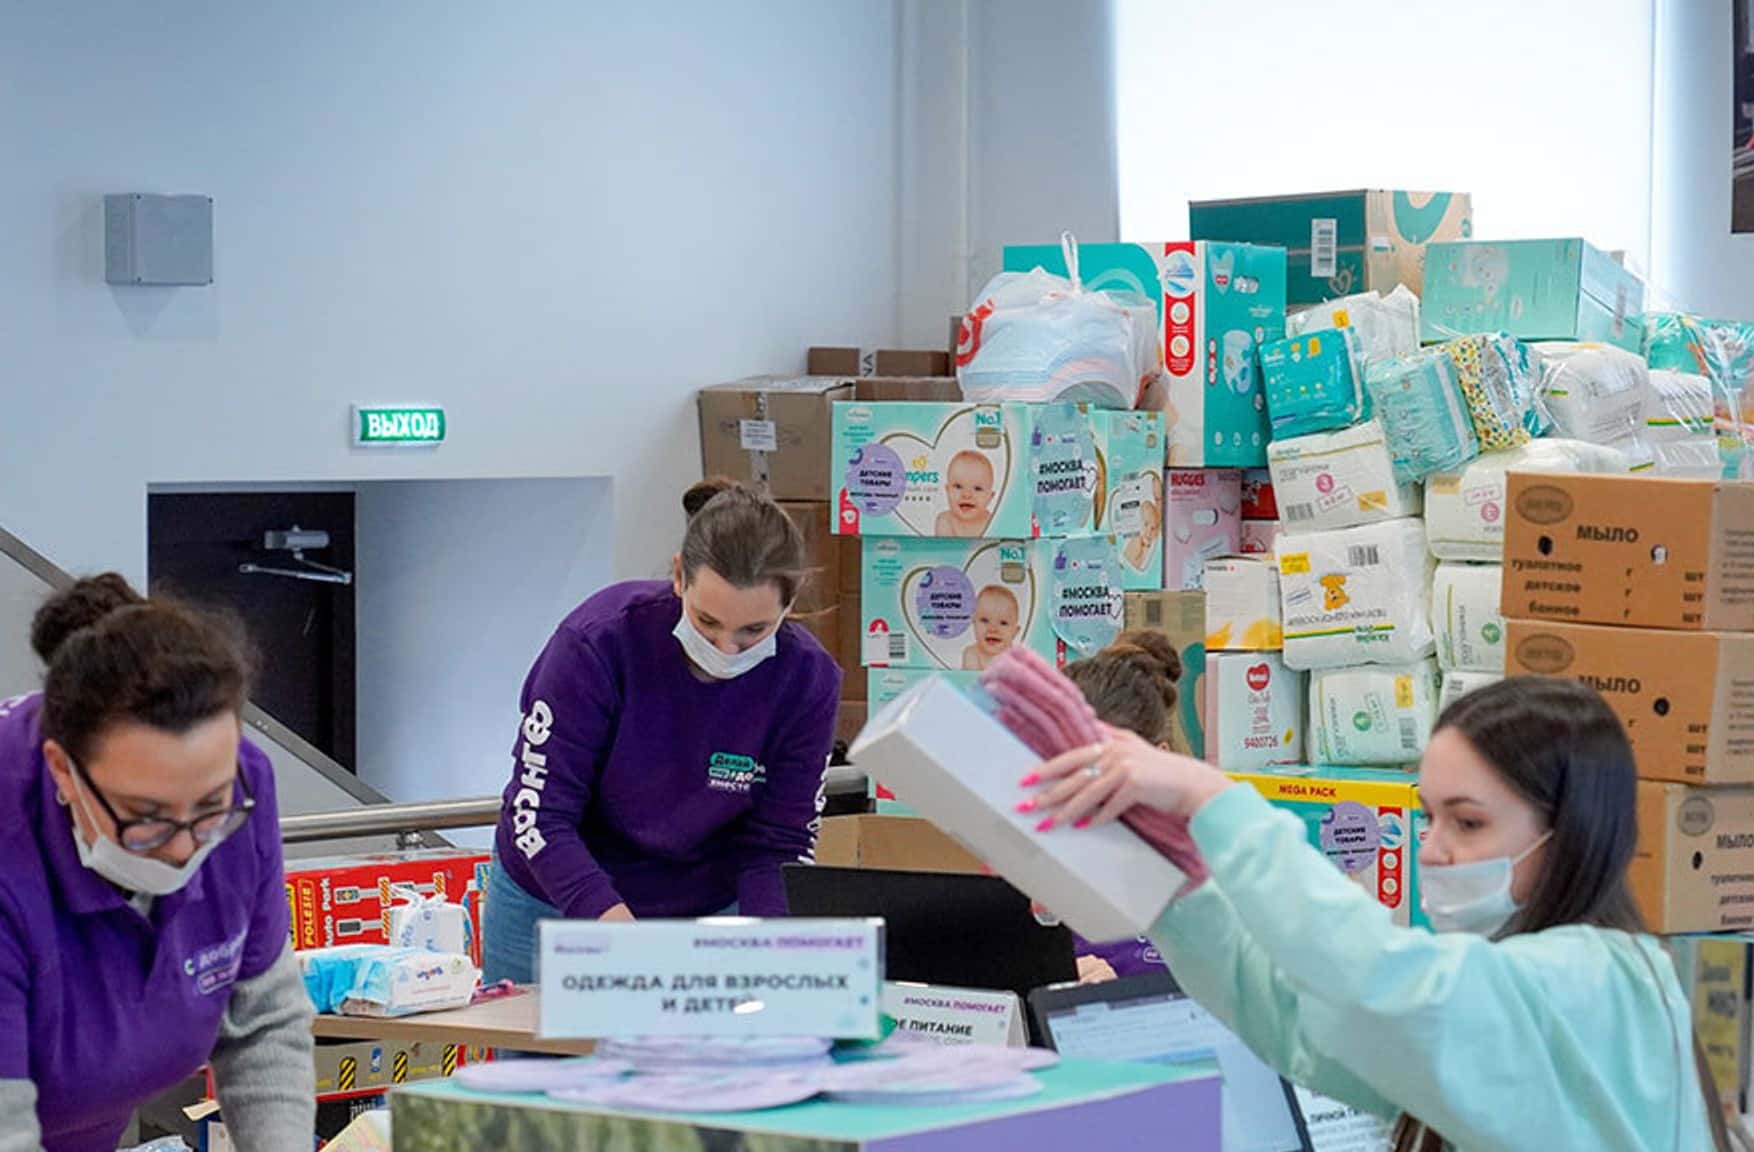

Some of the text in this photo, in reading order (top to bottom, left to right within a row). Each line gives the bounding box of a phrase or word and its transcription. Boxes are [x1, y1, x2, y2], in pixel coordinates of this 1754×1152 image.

[367, 412, 440, 438] ВЫХОД
[1039, 459, 1083, 475] #МОСКВА
[1037, 476, 1086, 494] ПОМОГАЕТ
[1576, 525, 1639, 543] МЫЛО
[1511, 559, 1583, 573] туалетное
[1062, 586, 1110, 599] #МОСКВА
[1524, 580, 1582, 593] детское
[1059, 602, 1113, 617] ПОМОГАЕТ
[1529, 601, 1581, 616] банное
[1279, 785, 1337, 798] MEGA PACK
[302, 887, 315, 945] POLESIE
[693, 936, 865, 949] #МОСКВА ПОМОГАЕТ
[562, 974, 849, 991] ОДЕЖДА ДЛЯ ВЗРОСЛЫХ
[661, 997, 677, 1012] И
[904, 997, 1006, 1014] #МОСКВА ПОМОГАЕТ
[910, 1020, 974, 1036] ПИТАНИЕ
